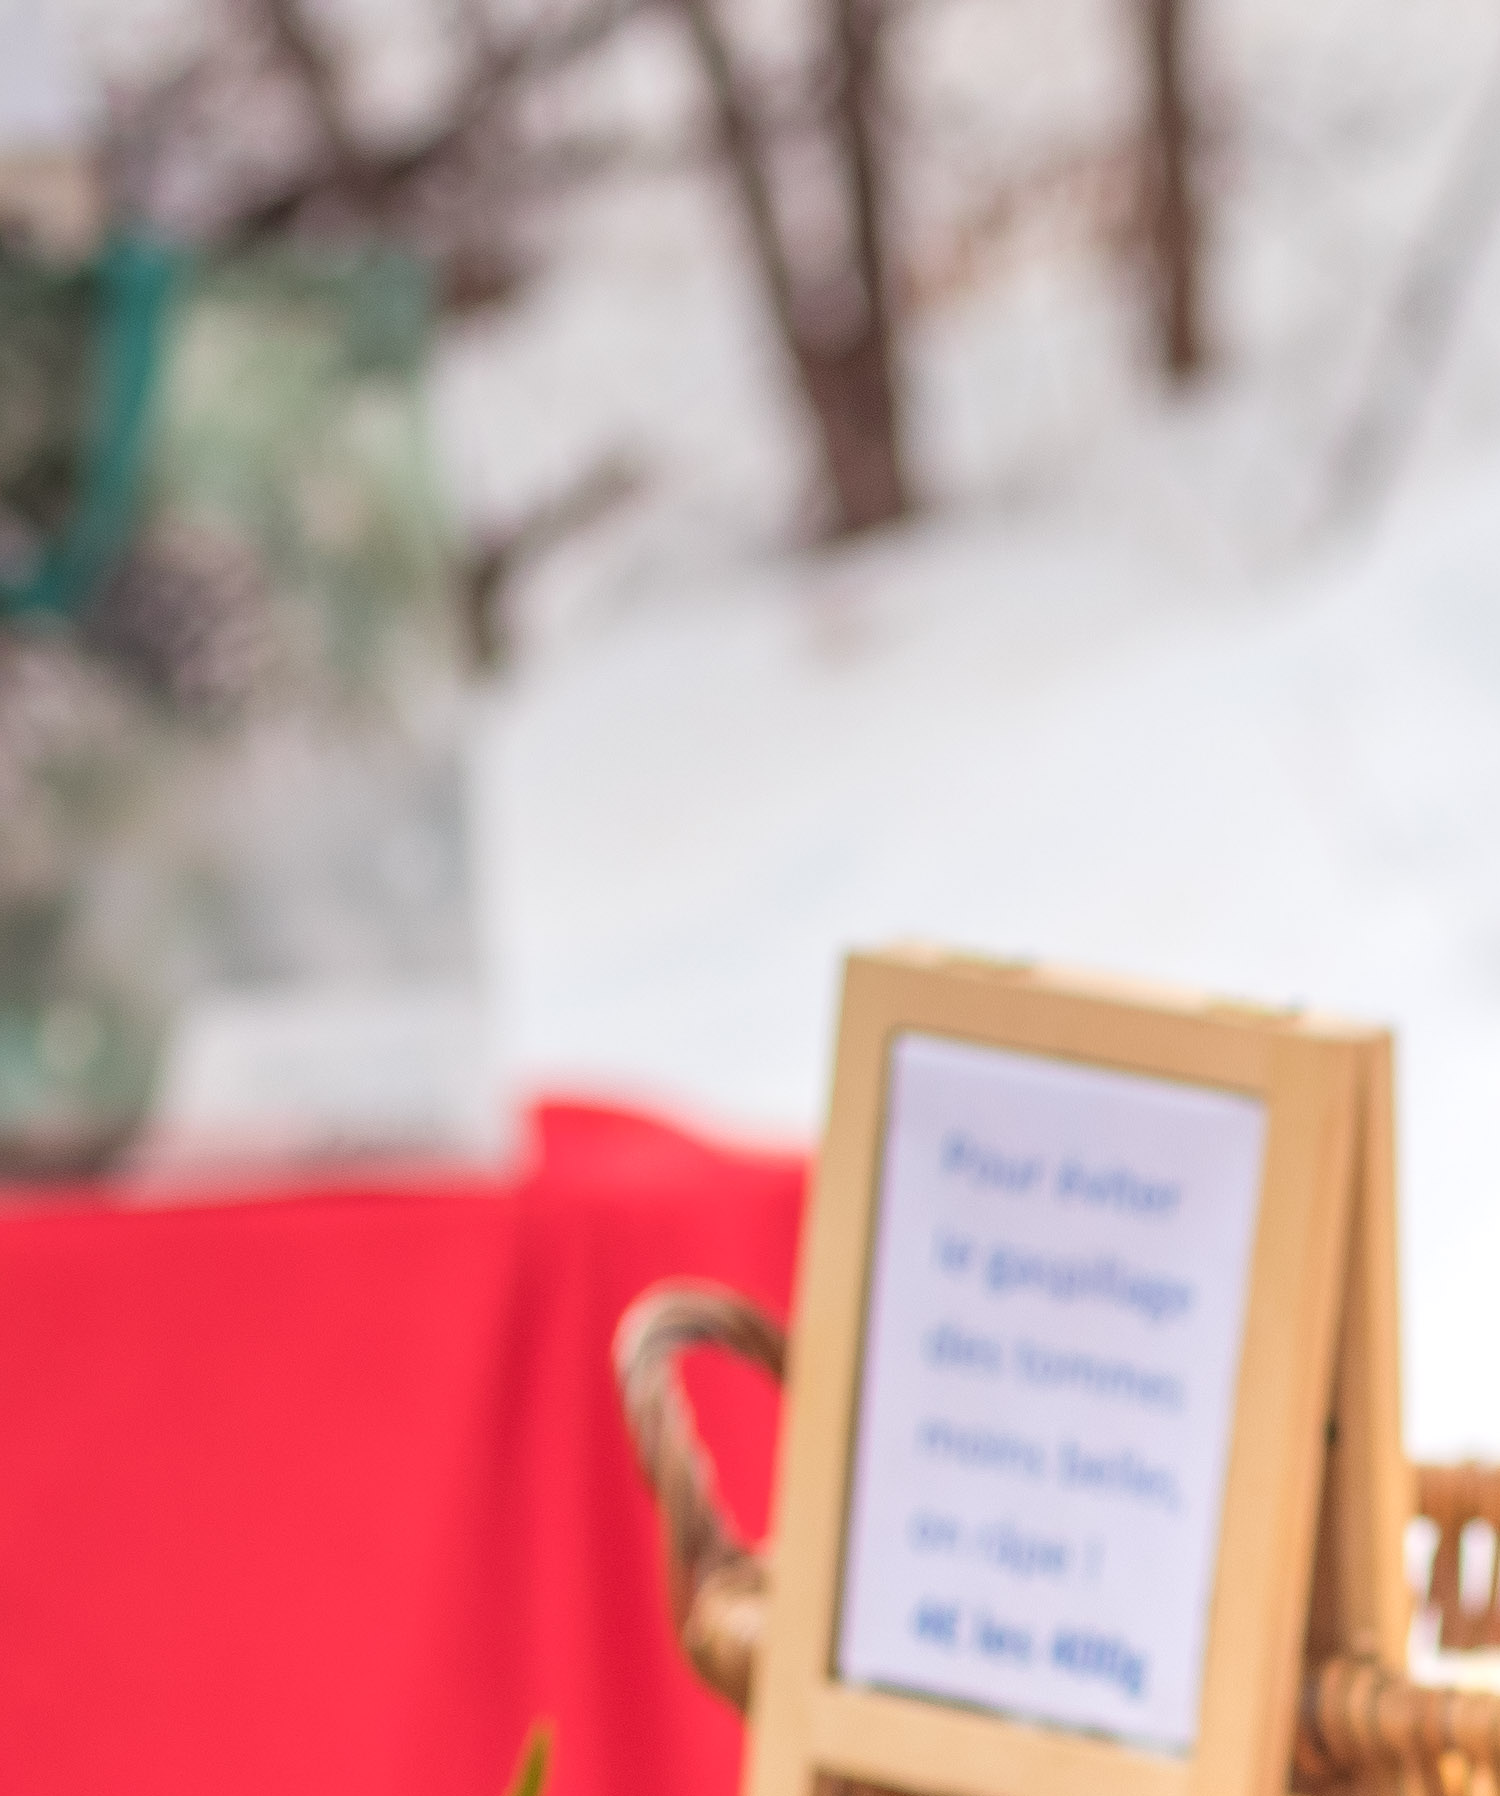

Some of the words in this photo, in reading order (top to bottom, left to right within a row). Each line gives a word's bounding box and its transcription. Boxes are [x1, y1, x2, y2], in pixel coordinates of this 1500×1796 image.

[942, 1133, 1043, 1196] Pour
[937, 1230, 978, 1274] le
[926, 1322, 1004, 1375] des
[917, 1416, 1047, 1480] moins
[912, 1512, 963, 1554] on
[972, 1608, 1037, 1664] les
